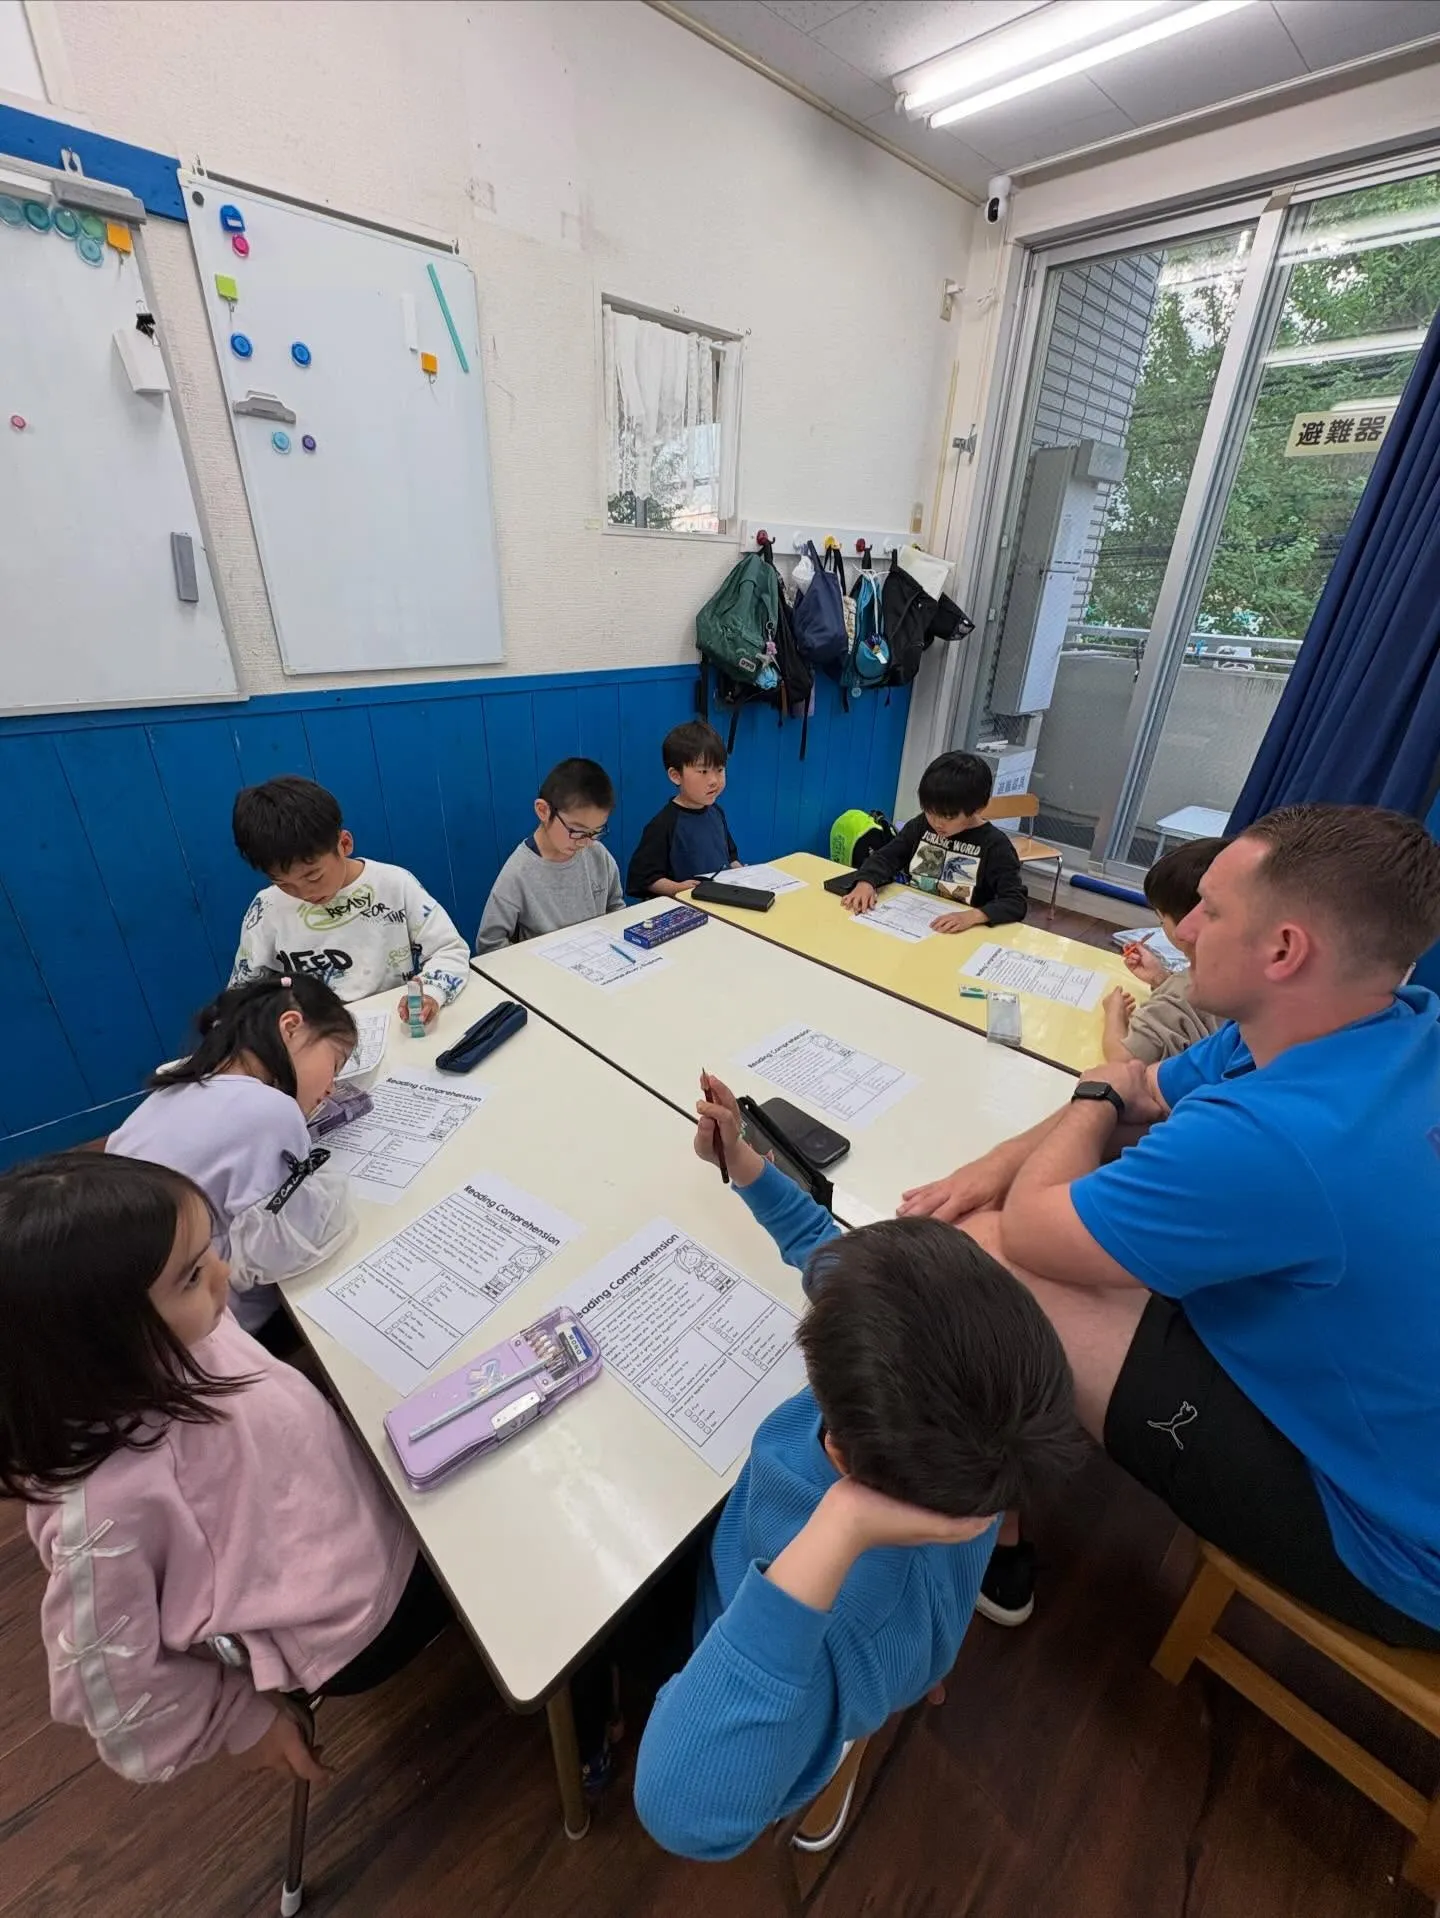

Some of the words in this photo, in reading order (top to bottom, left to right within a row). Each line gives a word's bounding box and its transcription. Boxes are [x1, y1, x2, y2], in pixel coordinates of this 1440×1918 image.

[953, 840, 981, 855] WORLD
[325, 893, 371, 918] READY
[360, 903, 391, 918] FOR
[386, 1077, 418, 1089] Reading
[419, 1084, 482, 1102] Comprehension
[464, 1185, 496, 1208] Reading
[496, 1204, 560, 1246] Comprehension
[576, 1289, 612, 1319] eading
[609, 1233, 680, 1290] Comprehension
[568, 1334, 582, 1355] MONO
